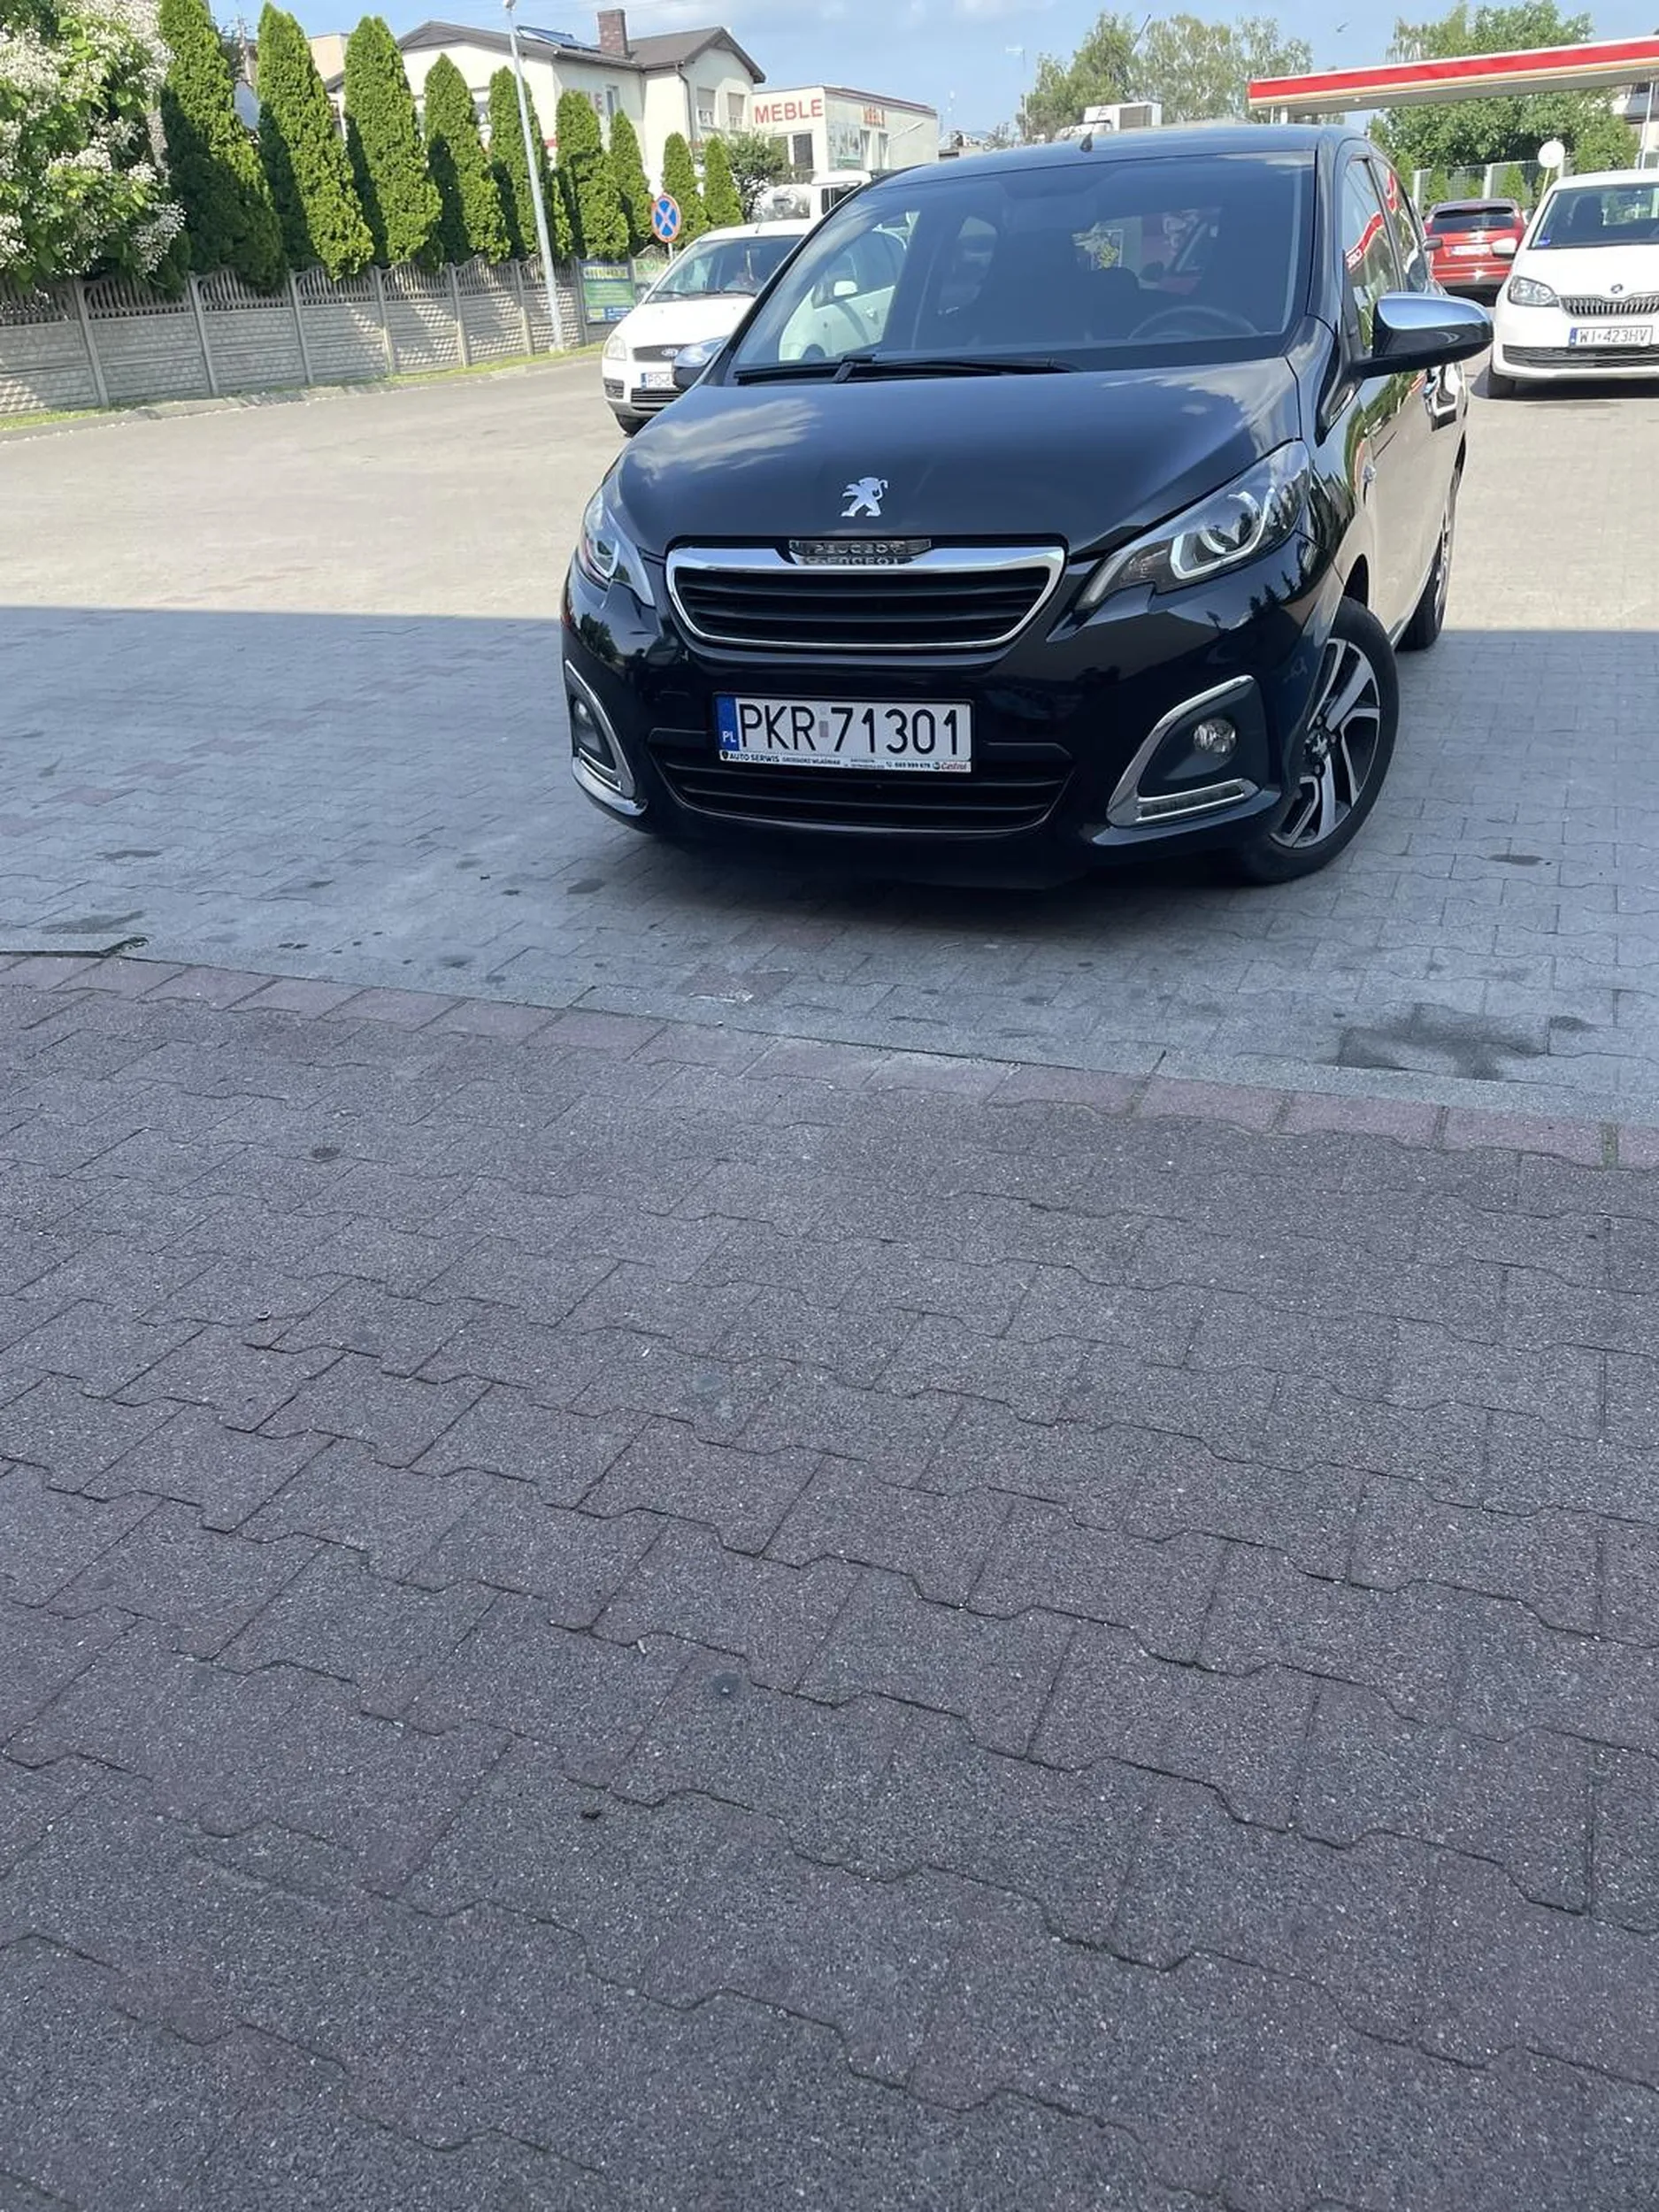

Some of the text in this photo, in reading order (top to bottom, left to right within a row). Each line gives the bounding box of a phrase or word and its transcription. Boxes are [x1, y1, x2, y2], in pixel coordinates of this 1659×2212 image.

[754, 98, 824, 125] MEBLE
[814, 543, 903, 555] PEUGEOT
[738, 703, 958, 756] PKR 71301
[722, 730, 736, 743] PL
[730, 752, 749, 761] AUTO
[750, 754, 780, 763] SERWIS
